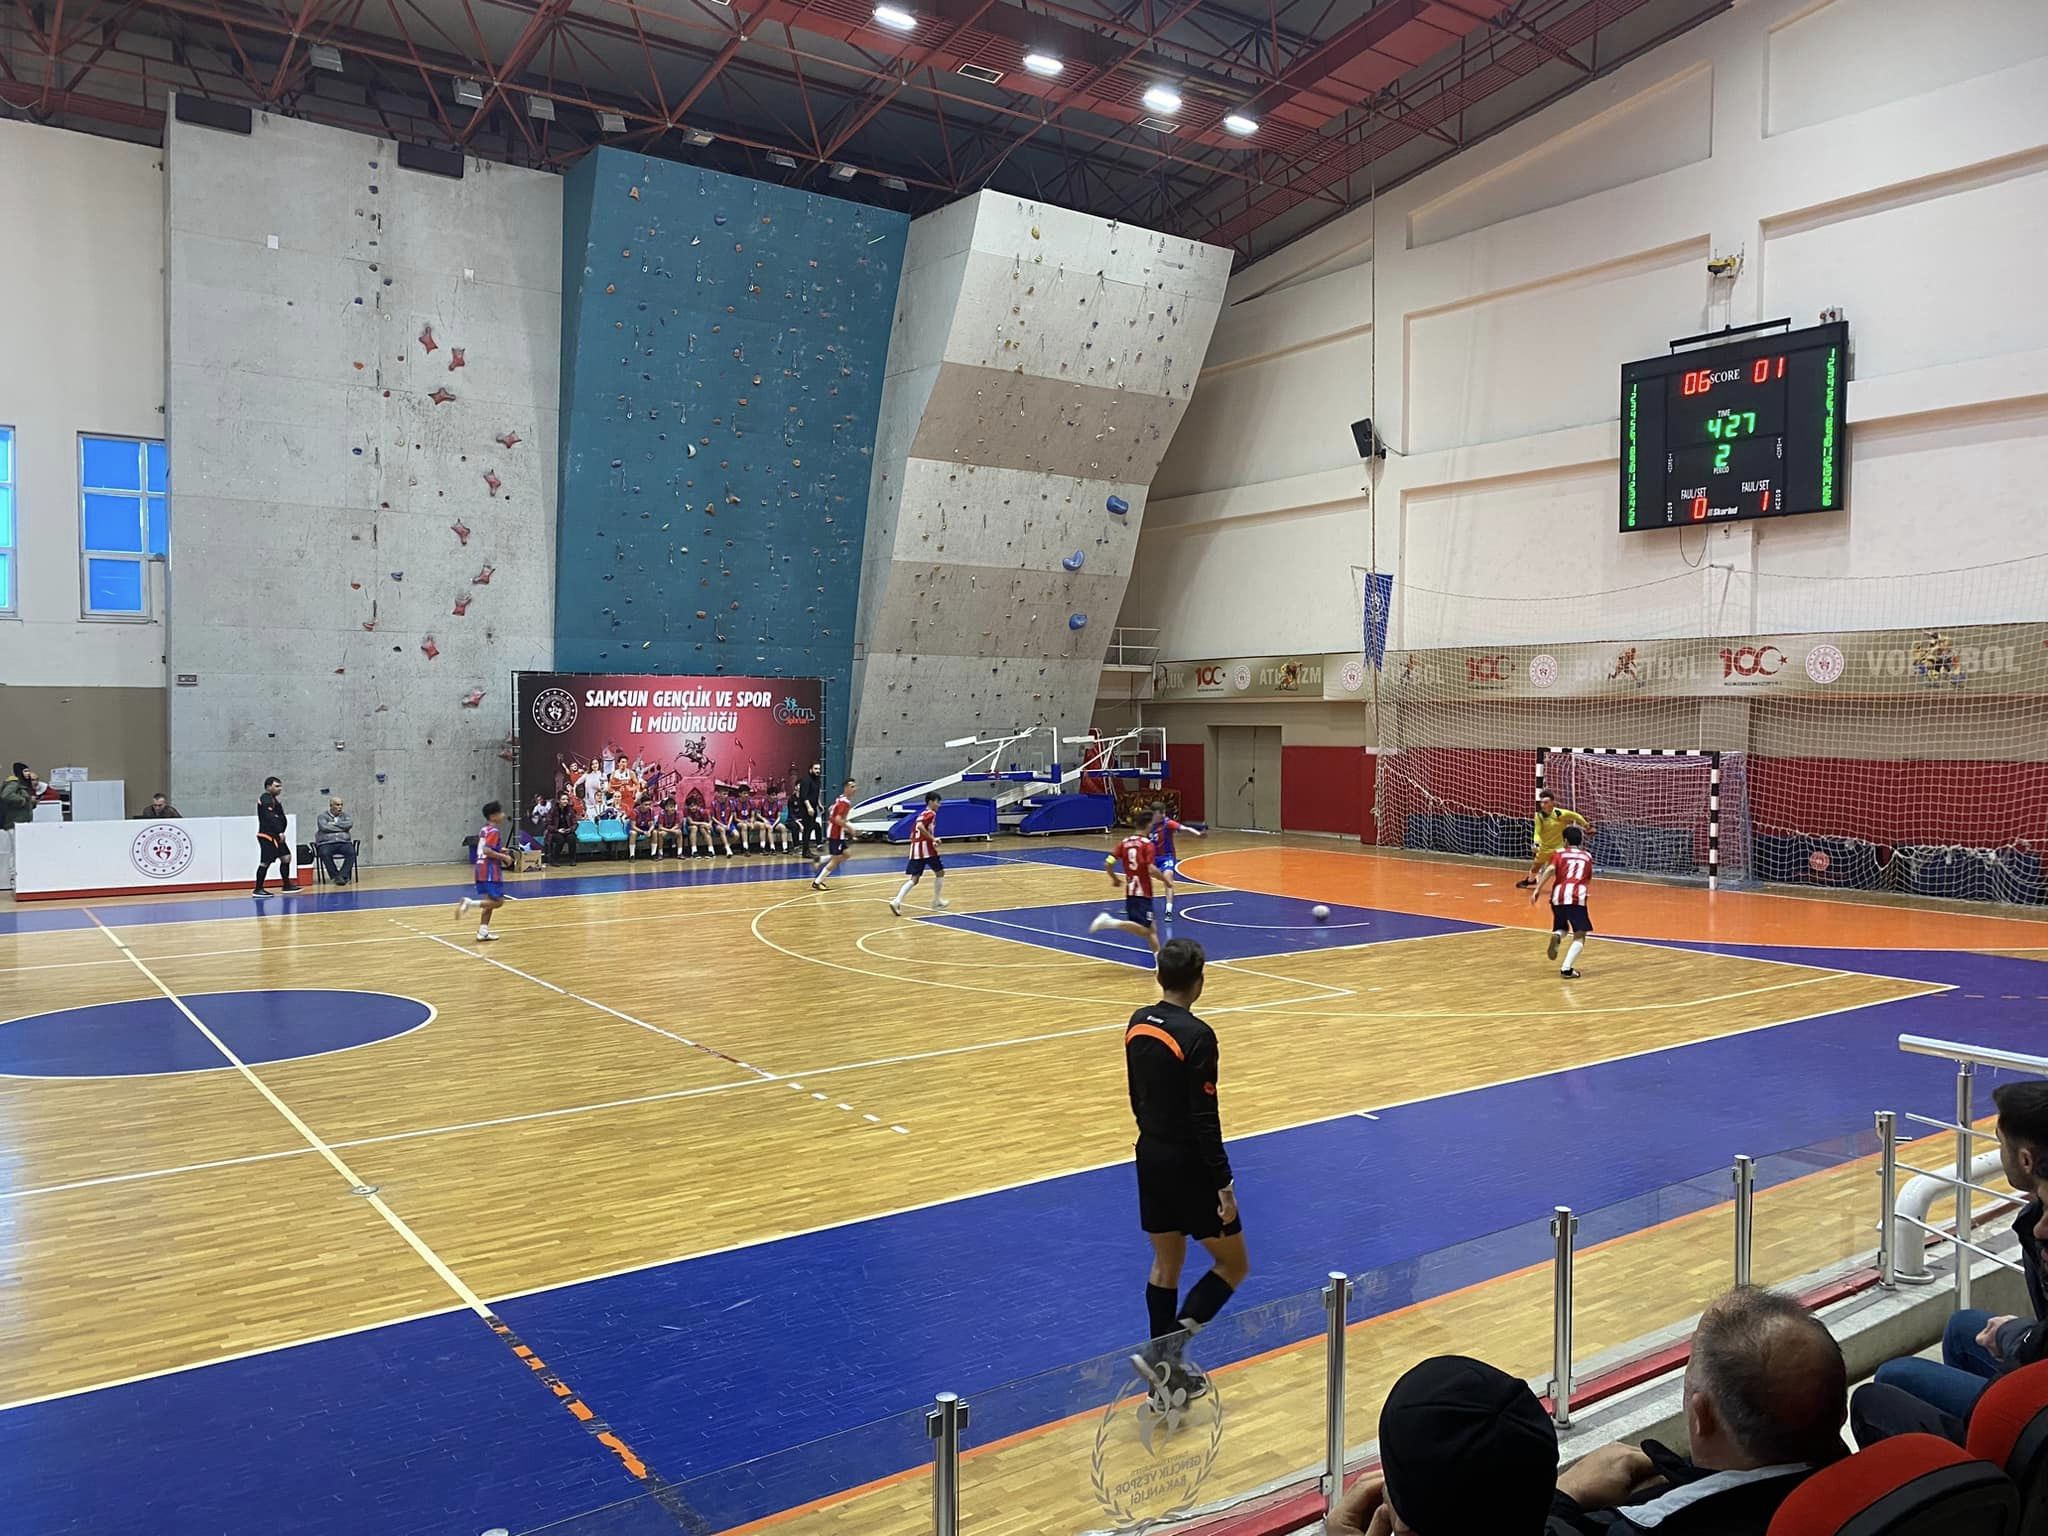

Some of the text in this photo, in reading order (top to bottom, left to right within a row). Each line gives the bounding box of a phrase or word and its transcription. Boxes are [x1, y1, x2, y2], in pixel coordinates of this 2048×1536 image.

[1684, 370, 1711, 395] 06
[1710, 368, 1740, 384] SCORE
[1717, 409, 1731, 417] TIME
[1715, 443, 1731, 468] 2
[1681, 486, 1708, 500] FAUL/SET
[1741, 479, 1770, 493] FAUL/SET
[1693, 497, 1708, 520] 0
[1762, 490, 1770, 511] 1
[585, 686, 772, 711] SAMSUN GENÇLİK VE SPOR
[630, 711, 738, 733] İL MÜDÜRLÜĞÜ
